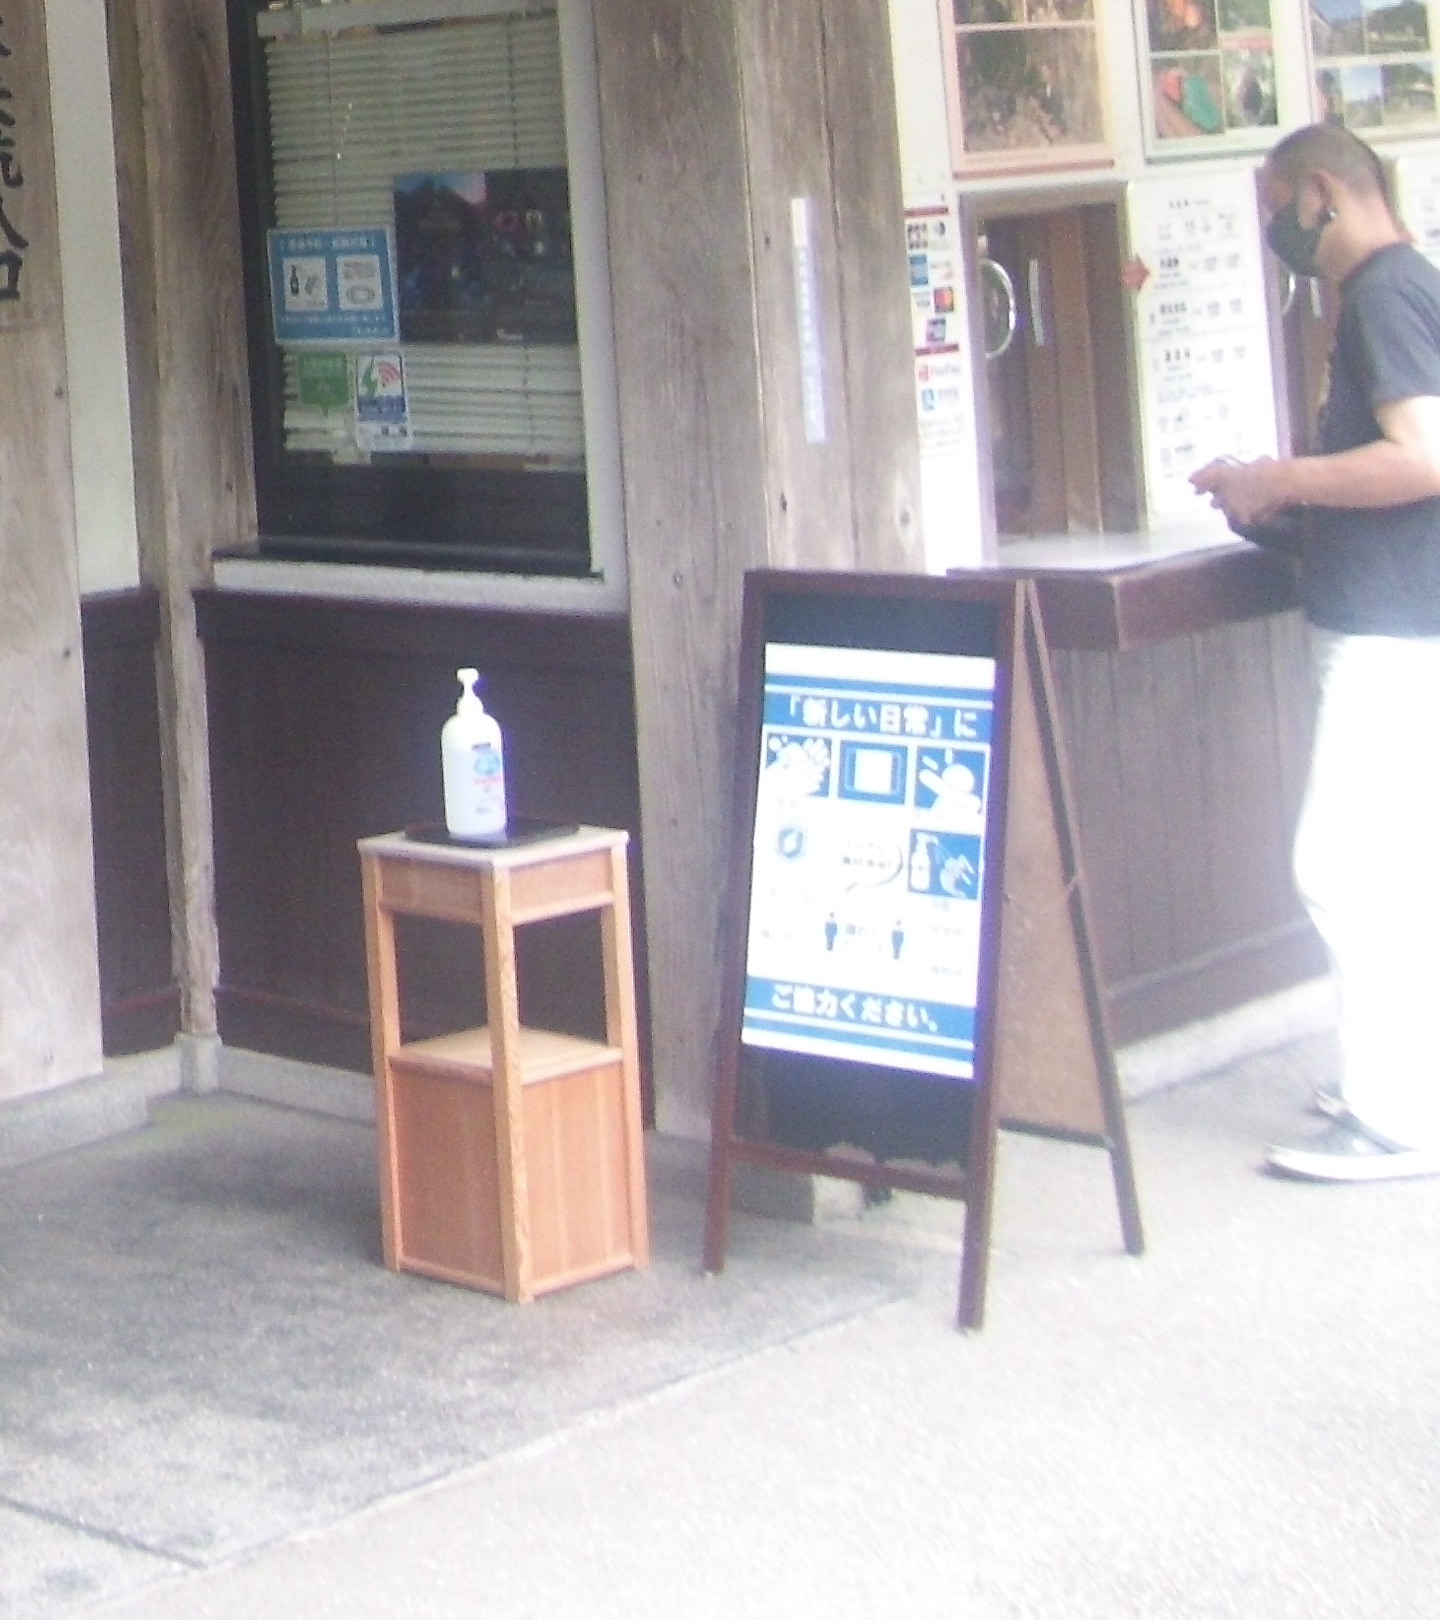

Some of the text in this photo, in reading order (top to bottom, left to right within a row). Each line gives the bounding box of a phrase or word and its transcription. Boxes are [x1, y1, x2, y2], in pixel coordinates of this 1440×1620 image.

[789, 695, 977, 738] 「新しい日常」に
[772, 984, 938, 1032] ご協力ください。
